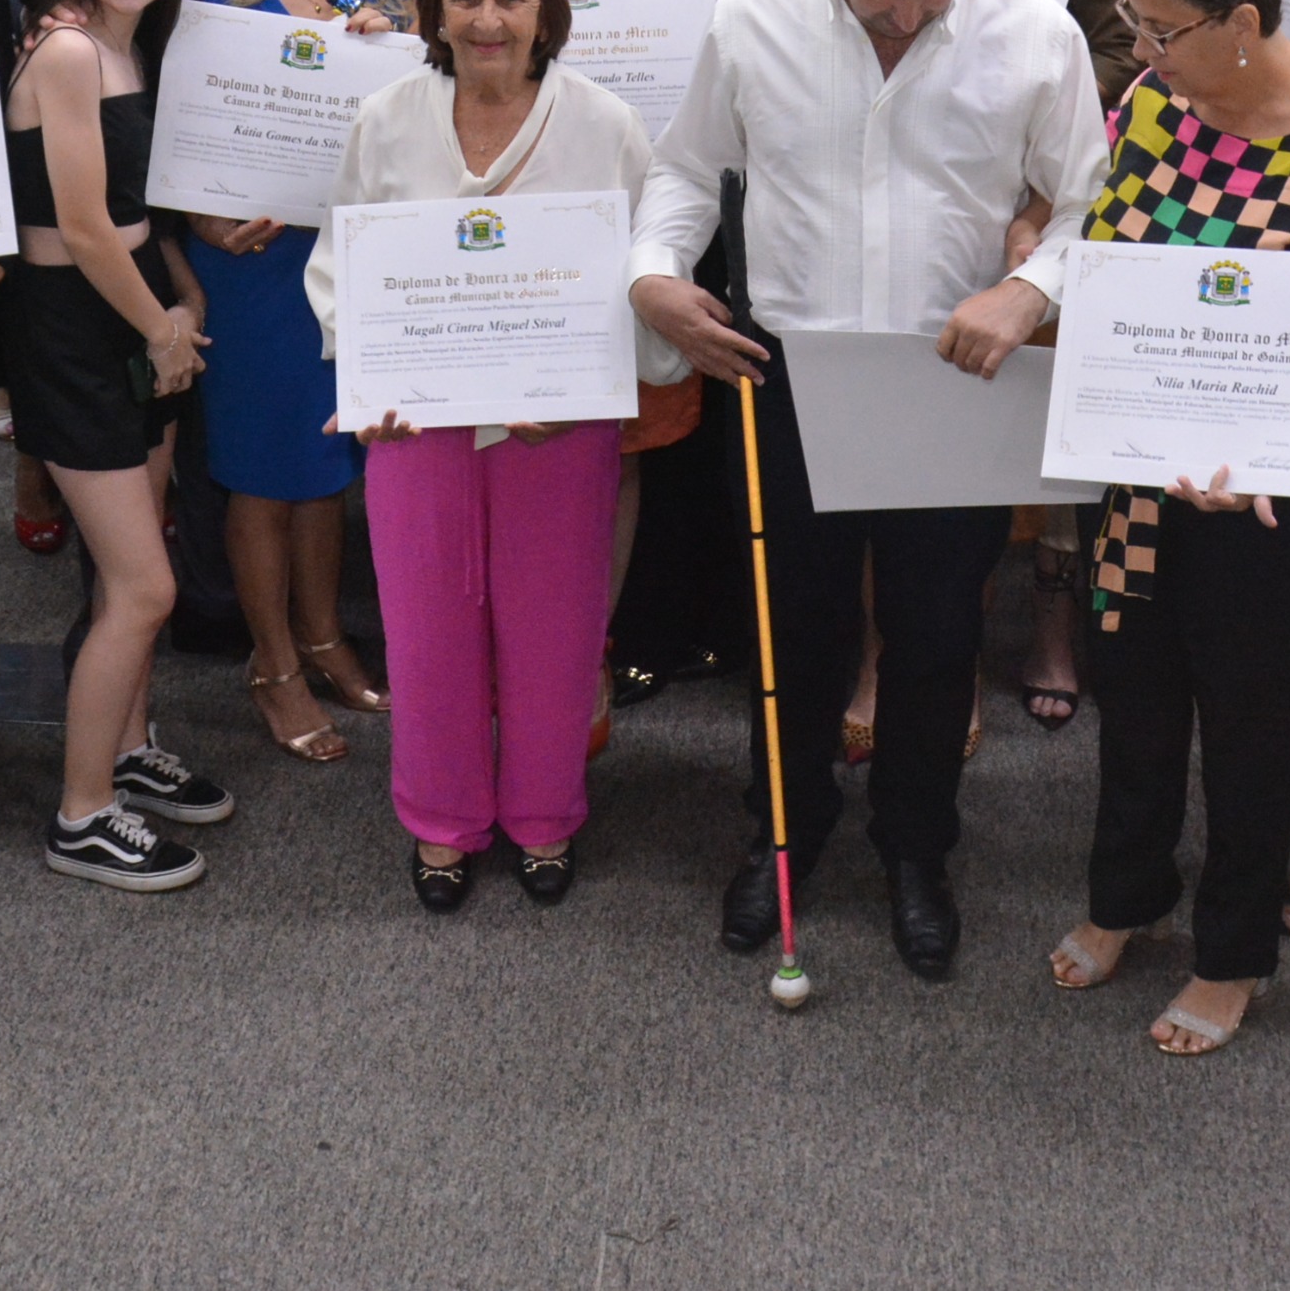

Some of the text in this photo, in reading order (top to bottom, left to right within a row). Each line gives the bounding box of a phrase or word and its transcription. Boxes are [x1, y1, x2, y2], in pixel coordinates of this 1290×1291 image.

[606, 29, 621, 39] ao
[625, 26, 668, 40] Mérito
[625, 72, 655, 83] Telles
[205, 74, 260, 95] Diploma
[263, 83, 277, 96] de
[281, 86, 321, 104] Honra
[325, 94, 339, 106] ao
[223, 94, 261, 110] Câmara
[262, 100, 312, 117] Municipal
[315, 108, 325, 119] de
[327, 109, 355, 124] Goiâ
[233, 123, 345, 150] Kátia Gomes da Silv
[383, 266, 581, 292] Diploma de Honra ao Mérito
[405, 287, 560, 306] Câmara Municipal de Goiânia
[401, 316, 566, 339] Magali Cintra Miguel Stival
[1112, 320, 1175, 340] Diploma
[1179, 324, 1197, 341] de
[1201, 326, 1249, 346] Honra
[1253, 332, 1271, 346] ao
[1133, 342, 1178, 357] Câmara
[1180, 346, 1239, 362] Municipal
[1241, 350, 1254, 362] de
[1187, 377, 1229, 394] Maria
[1231, 379, 1279, 397] Rachid
